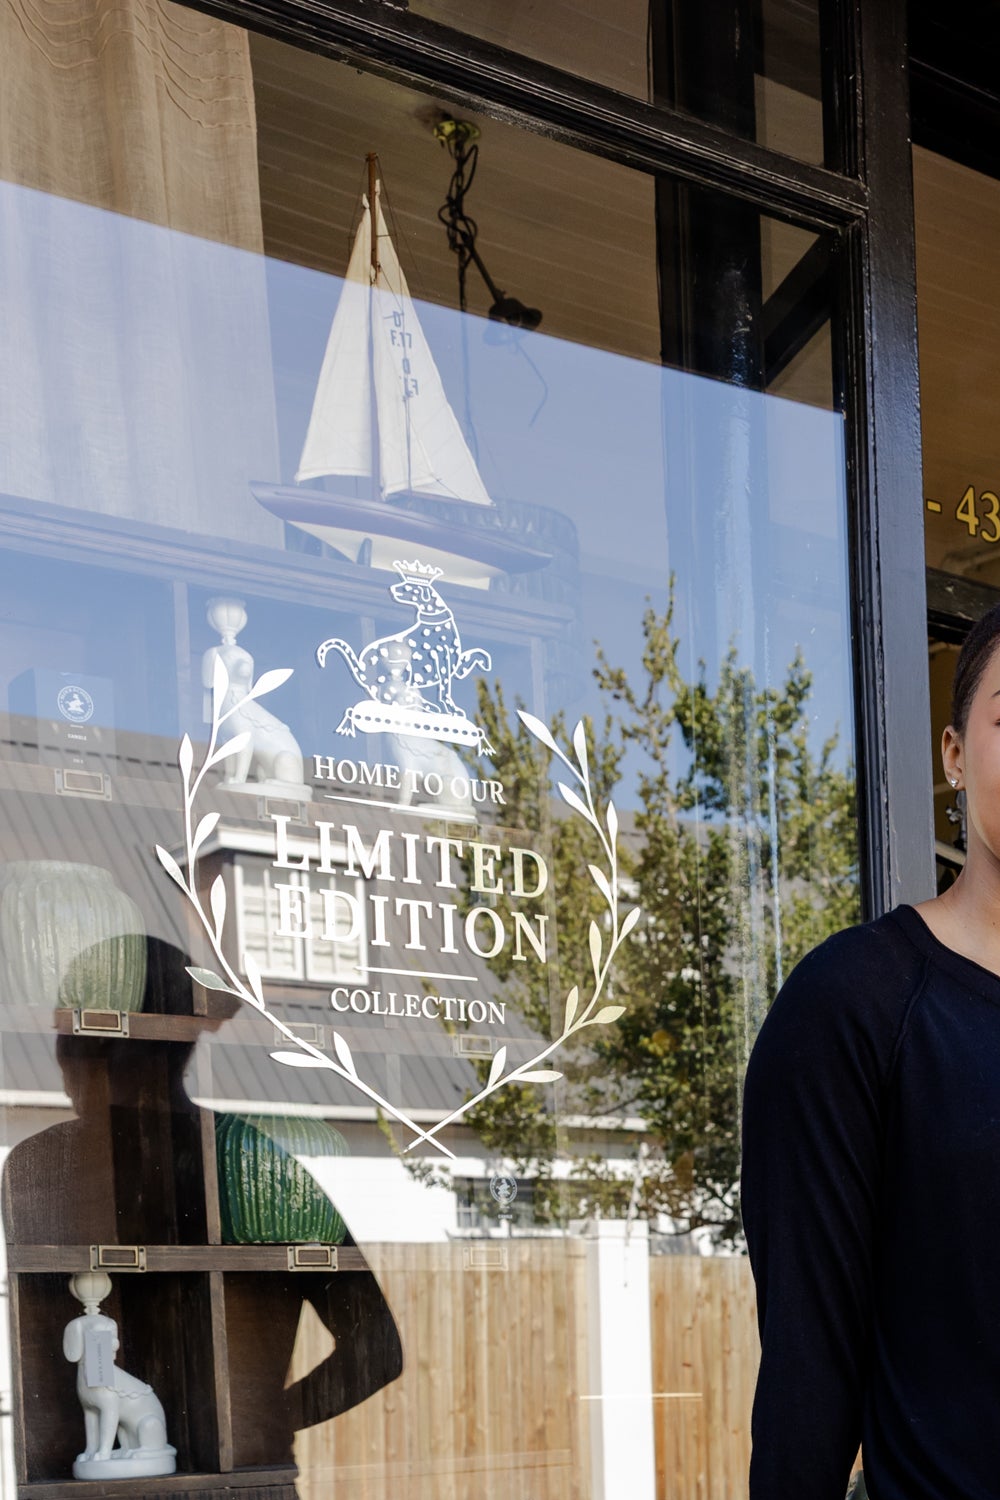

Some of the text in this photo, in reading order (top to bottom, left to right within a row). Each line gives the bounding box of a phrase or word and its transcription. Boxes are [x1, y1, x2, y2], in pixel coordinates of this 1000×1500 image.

[313, 755, 505, 805] HOME TO OUR
[271, 814, 549, 899] LIMITED
[275, 882, 549, 963] EDITION
[331, 987, 506, 1024] COLLECTION
